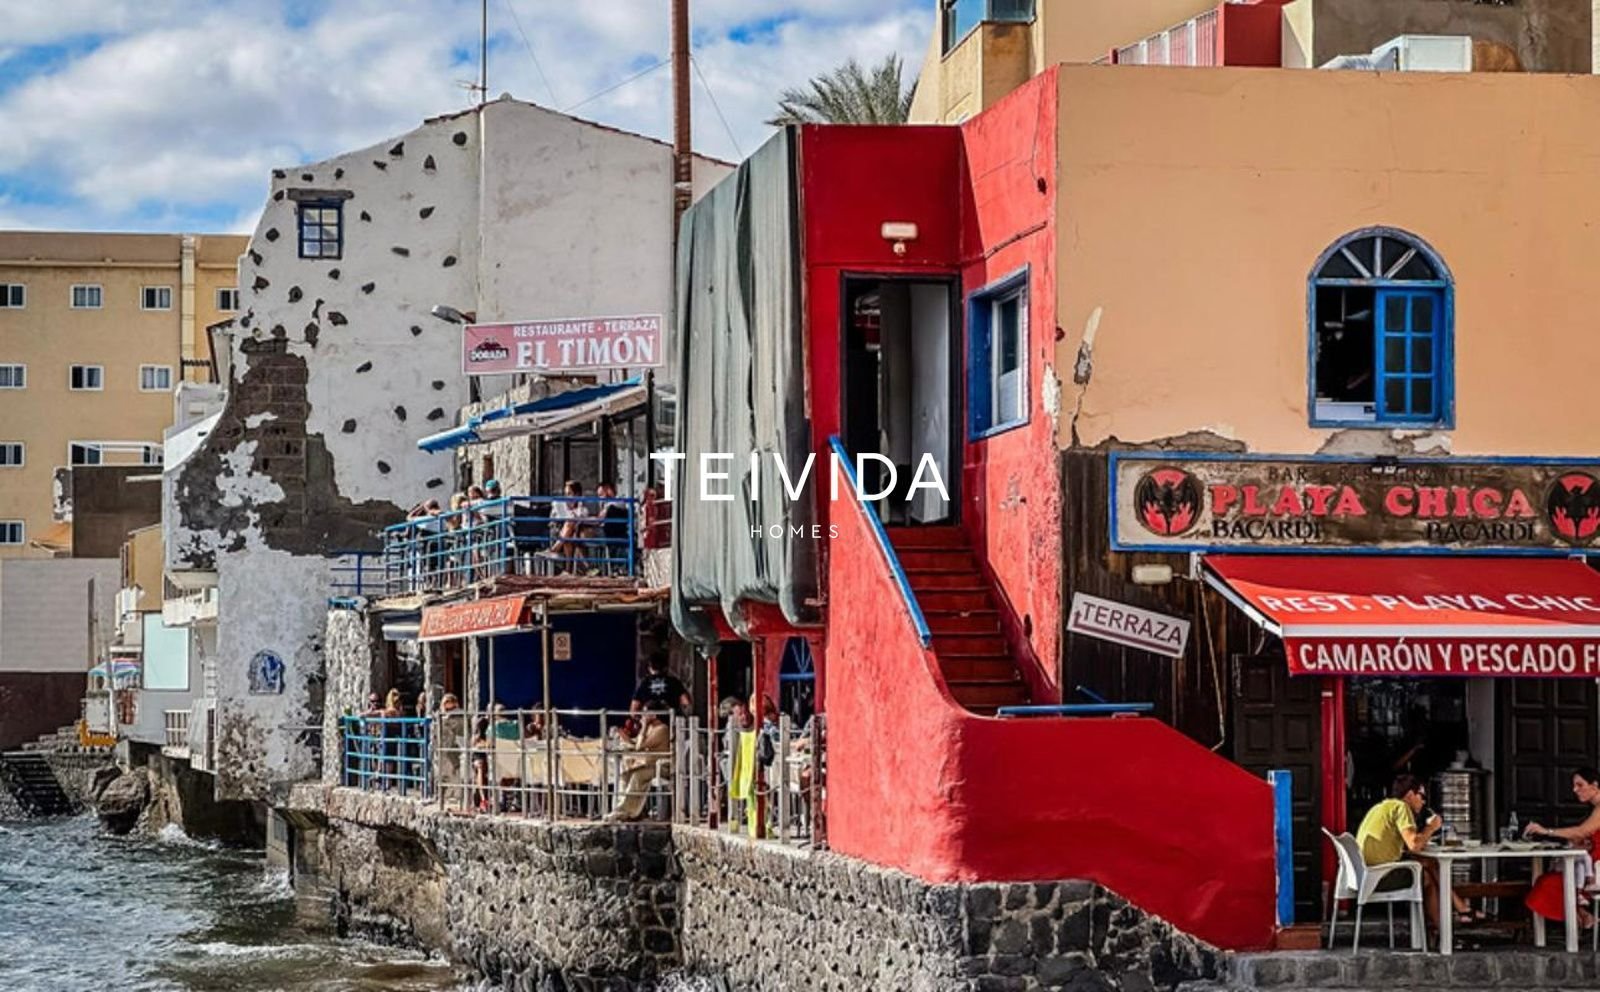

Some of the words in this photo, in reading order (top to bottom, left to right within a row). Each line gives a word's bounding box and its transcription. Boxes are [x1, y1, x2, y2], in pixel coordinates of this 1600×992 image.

[513, 325, 594, 338] RESTAURANTE
[605, 319, 657, 332] TERRAZA
[516, 340, 550, 368] EL
[558, 333, 655, 366] TIMÓN
[1268, 466, 1308, 481] BAR
[1210, 484, 1367, 516] PLAYA
[1385, 486, 1536, 518] CHICA
[1211, 519, 1321, 540] BACARDI
[1425, 520, 1534, 541] BACARDI
[1258, 594, 1372, 612] REST.
[1371, 594, 1506, 611] PLAYA
[1083, 602, 1182, 645] TERRAZA
[1300, 637, 1433, 672] CAMARÓN
[1437, 643, 1453, 672] Y
[1459, 643, 1576, 673] PESCADO
[1583, 643, 1600, 673] F
